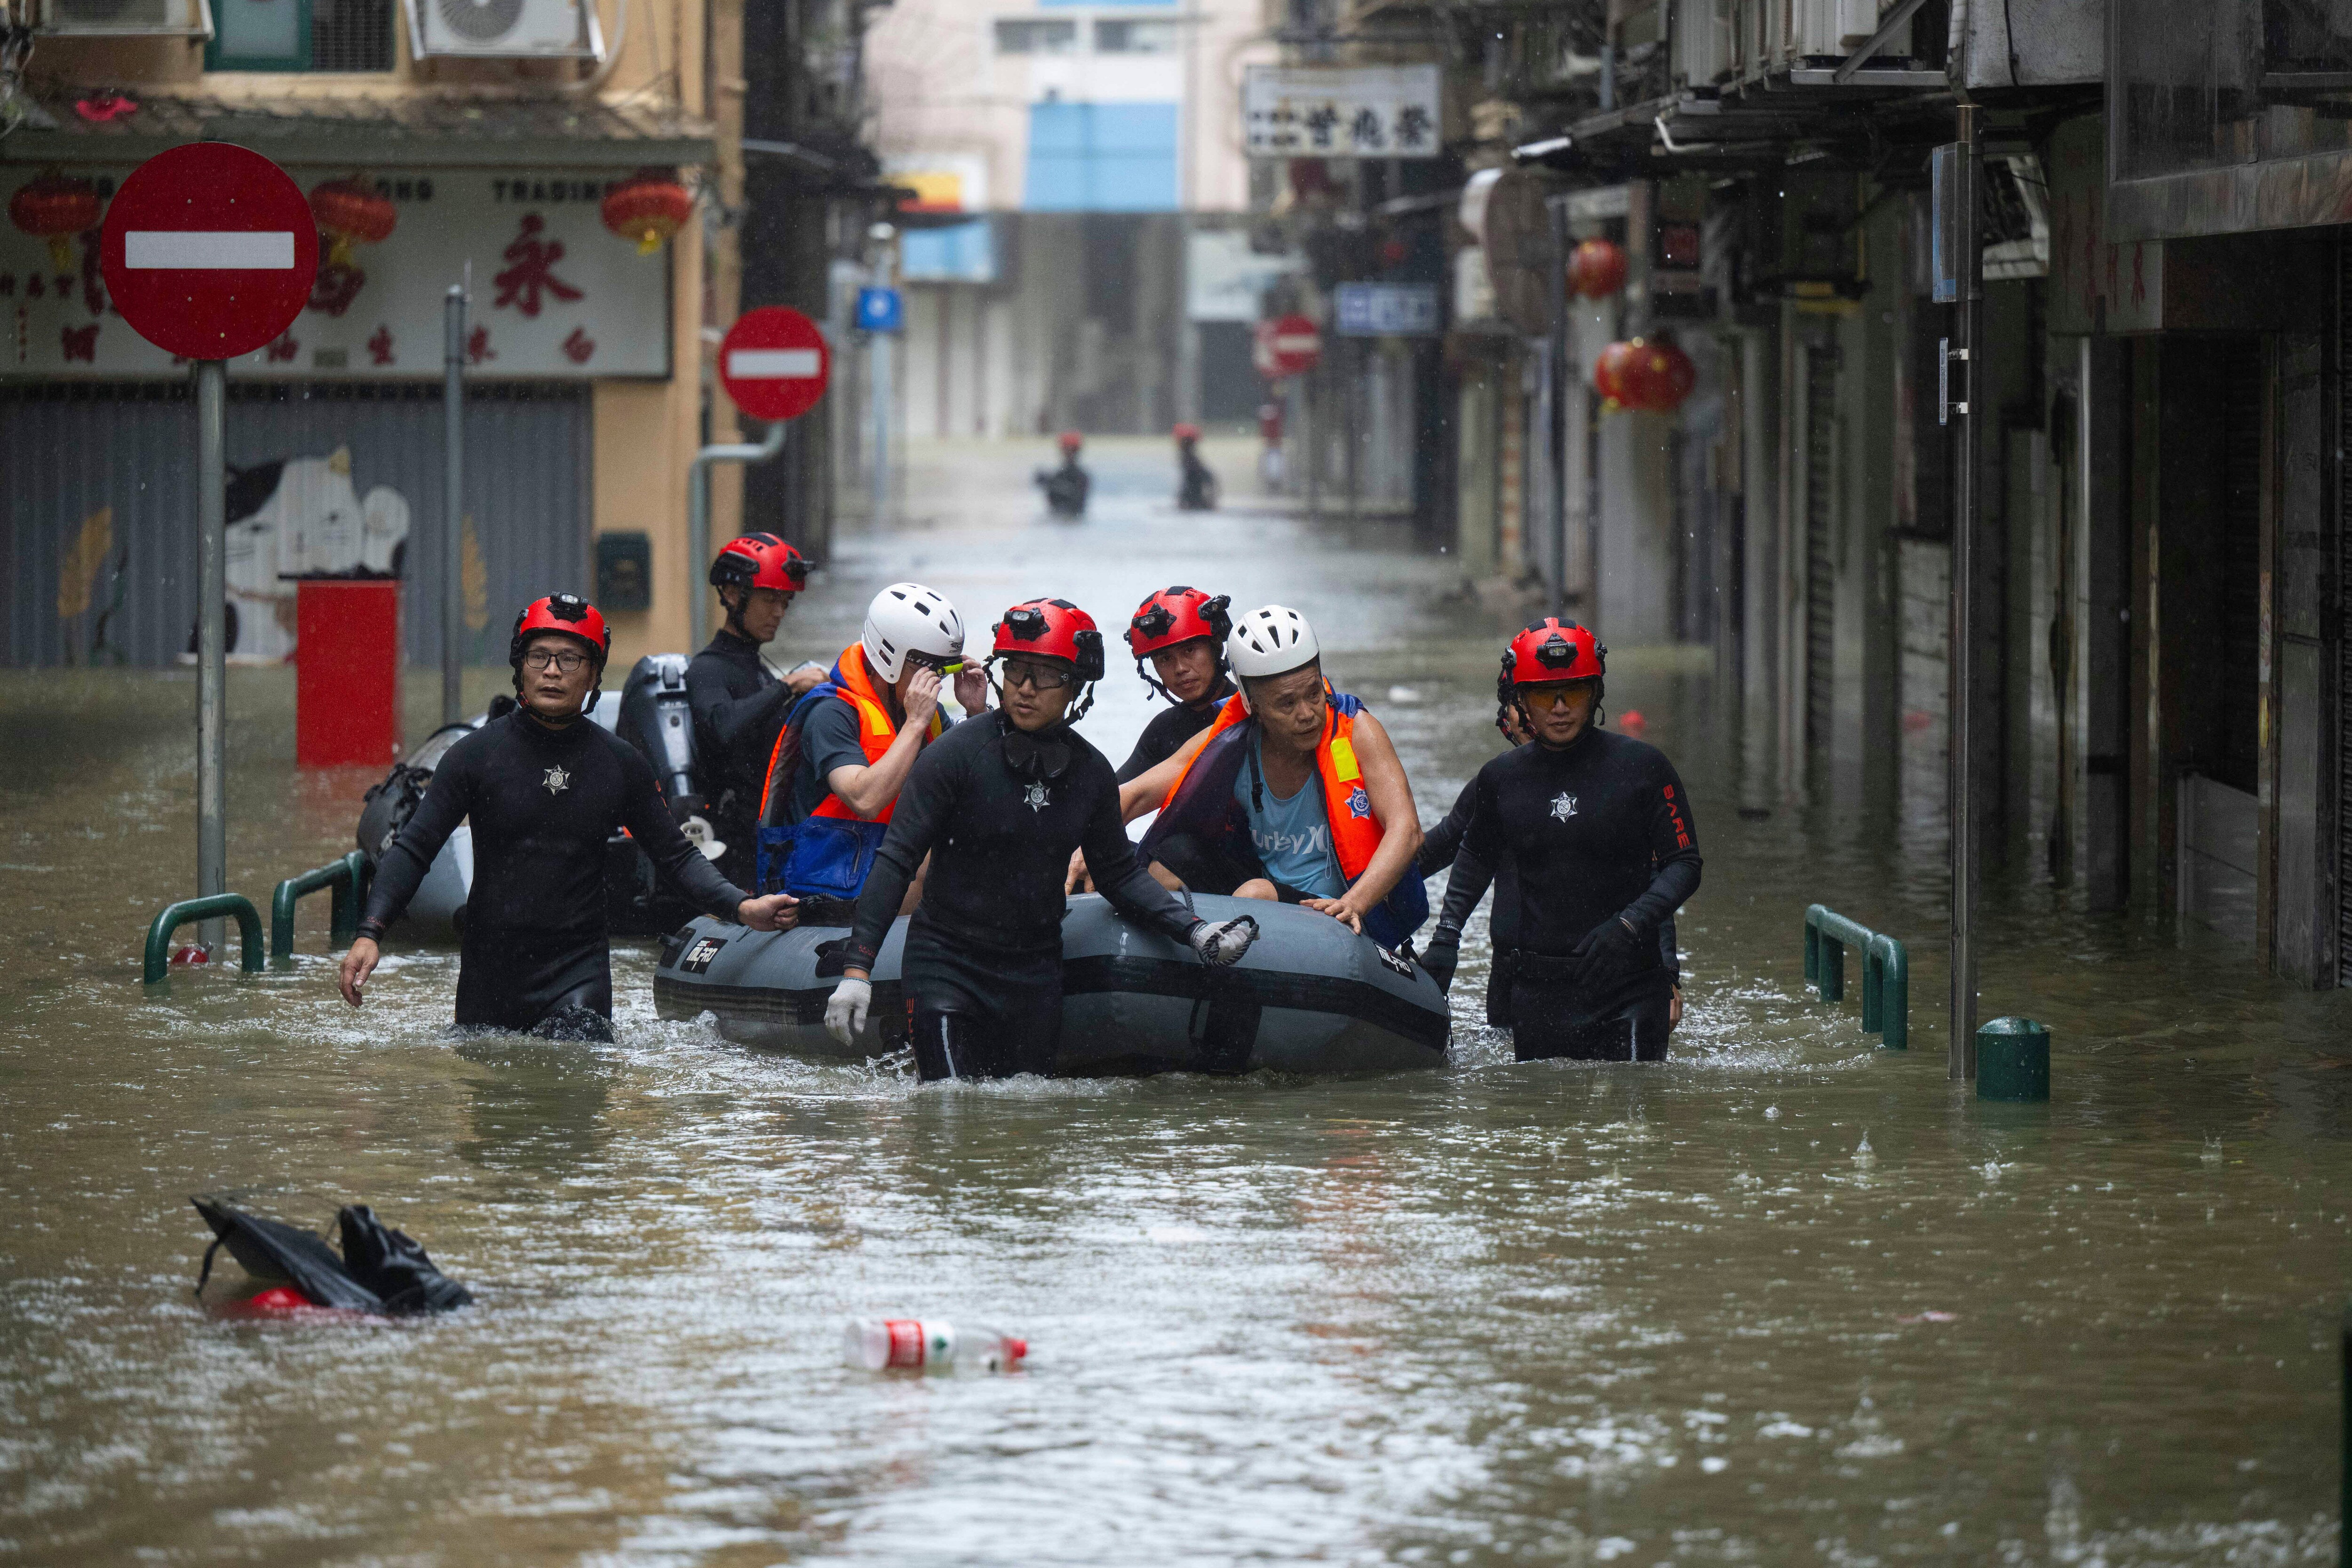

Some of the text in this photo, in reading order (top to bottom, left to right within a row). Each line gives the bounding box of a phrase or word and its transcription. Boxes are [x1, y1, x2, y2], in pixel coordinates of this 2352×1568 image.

[493, 179, 608, 201] TRADIN
[1663, 784, 1690, 849] BARE
[1251, 829, 1306, 854] urley
